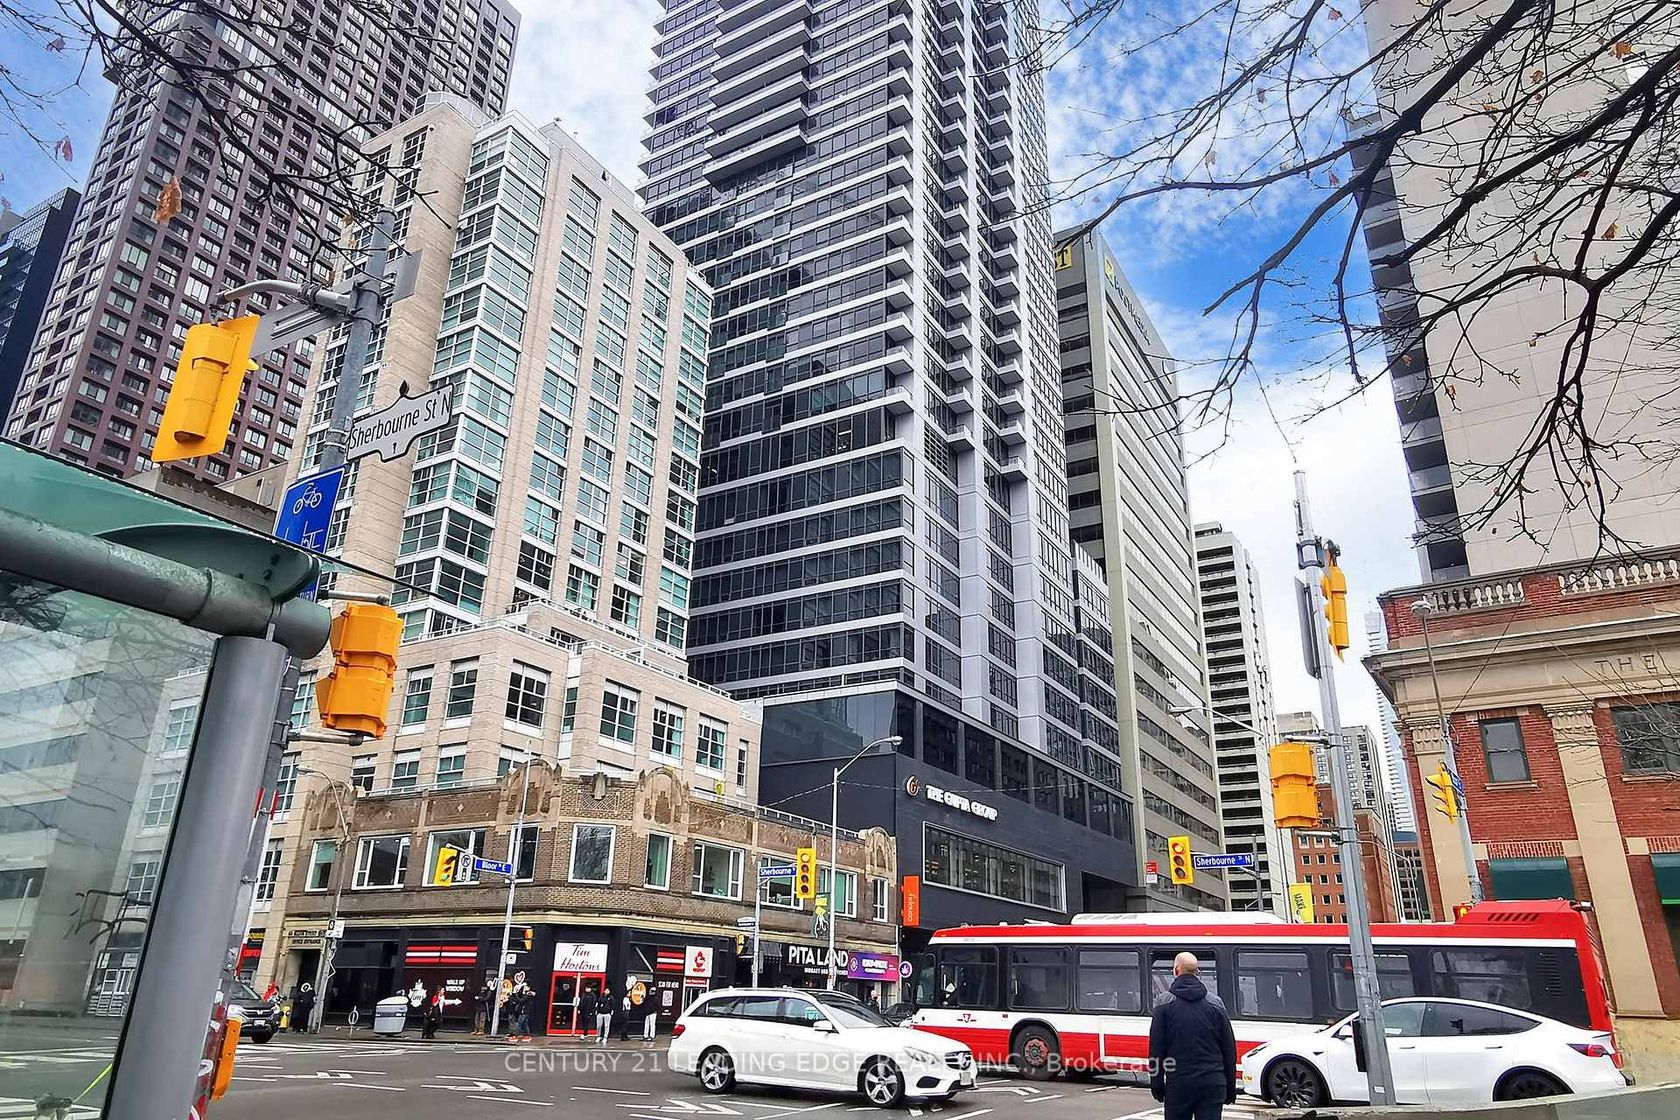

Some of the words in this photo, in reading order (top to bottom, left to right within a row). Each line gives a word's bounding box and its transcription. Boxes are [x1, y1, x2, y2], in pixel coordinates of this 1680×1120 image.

[349, 409, 420, 450] Sherbourne
[424, 399, 437, 422] St
[441, 392, 452, 416] N
[1593, 654, 1657, 675] THE
[925, 784, 945, 804] THE
[481, 860, 498, 870] Bloor
[1196, 856, 1236, 866] Sherbourne
[1245, 854, 1251, 864] N
[760, 868, 792, 876] Sherbourne
[572, 944, 591, 957] Tim
[788, 945, 816, 965] PITA
[816, 948, 849, 967] LAND
[560, 957, 600, 971] Hortons
